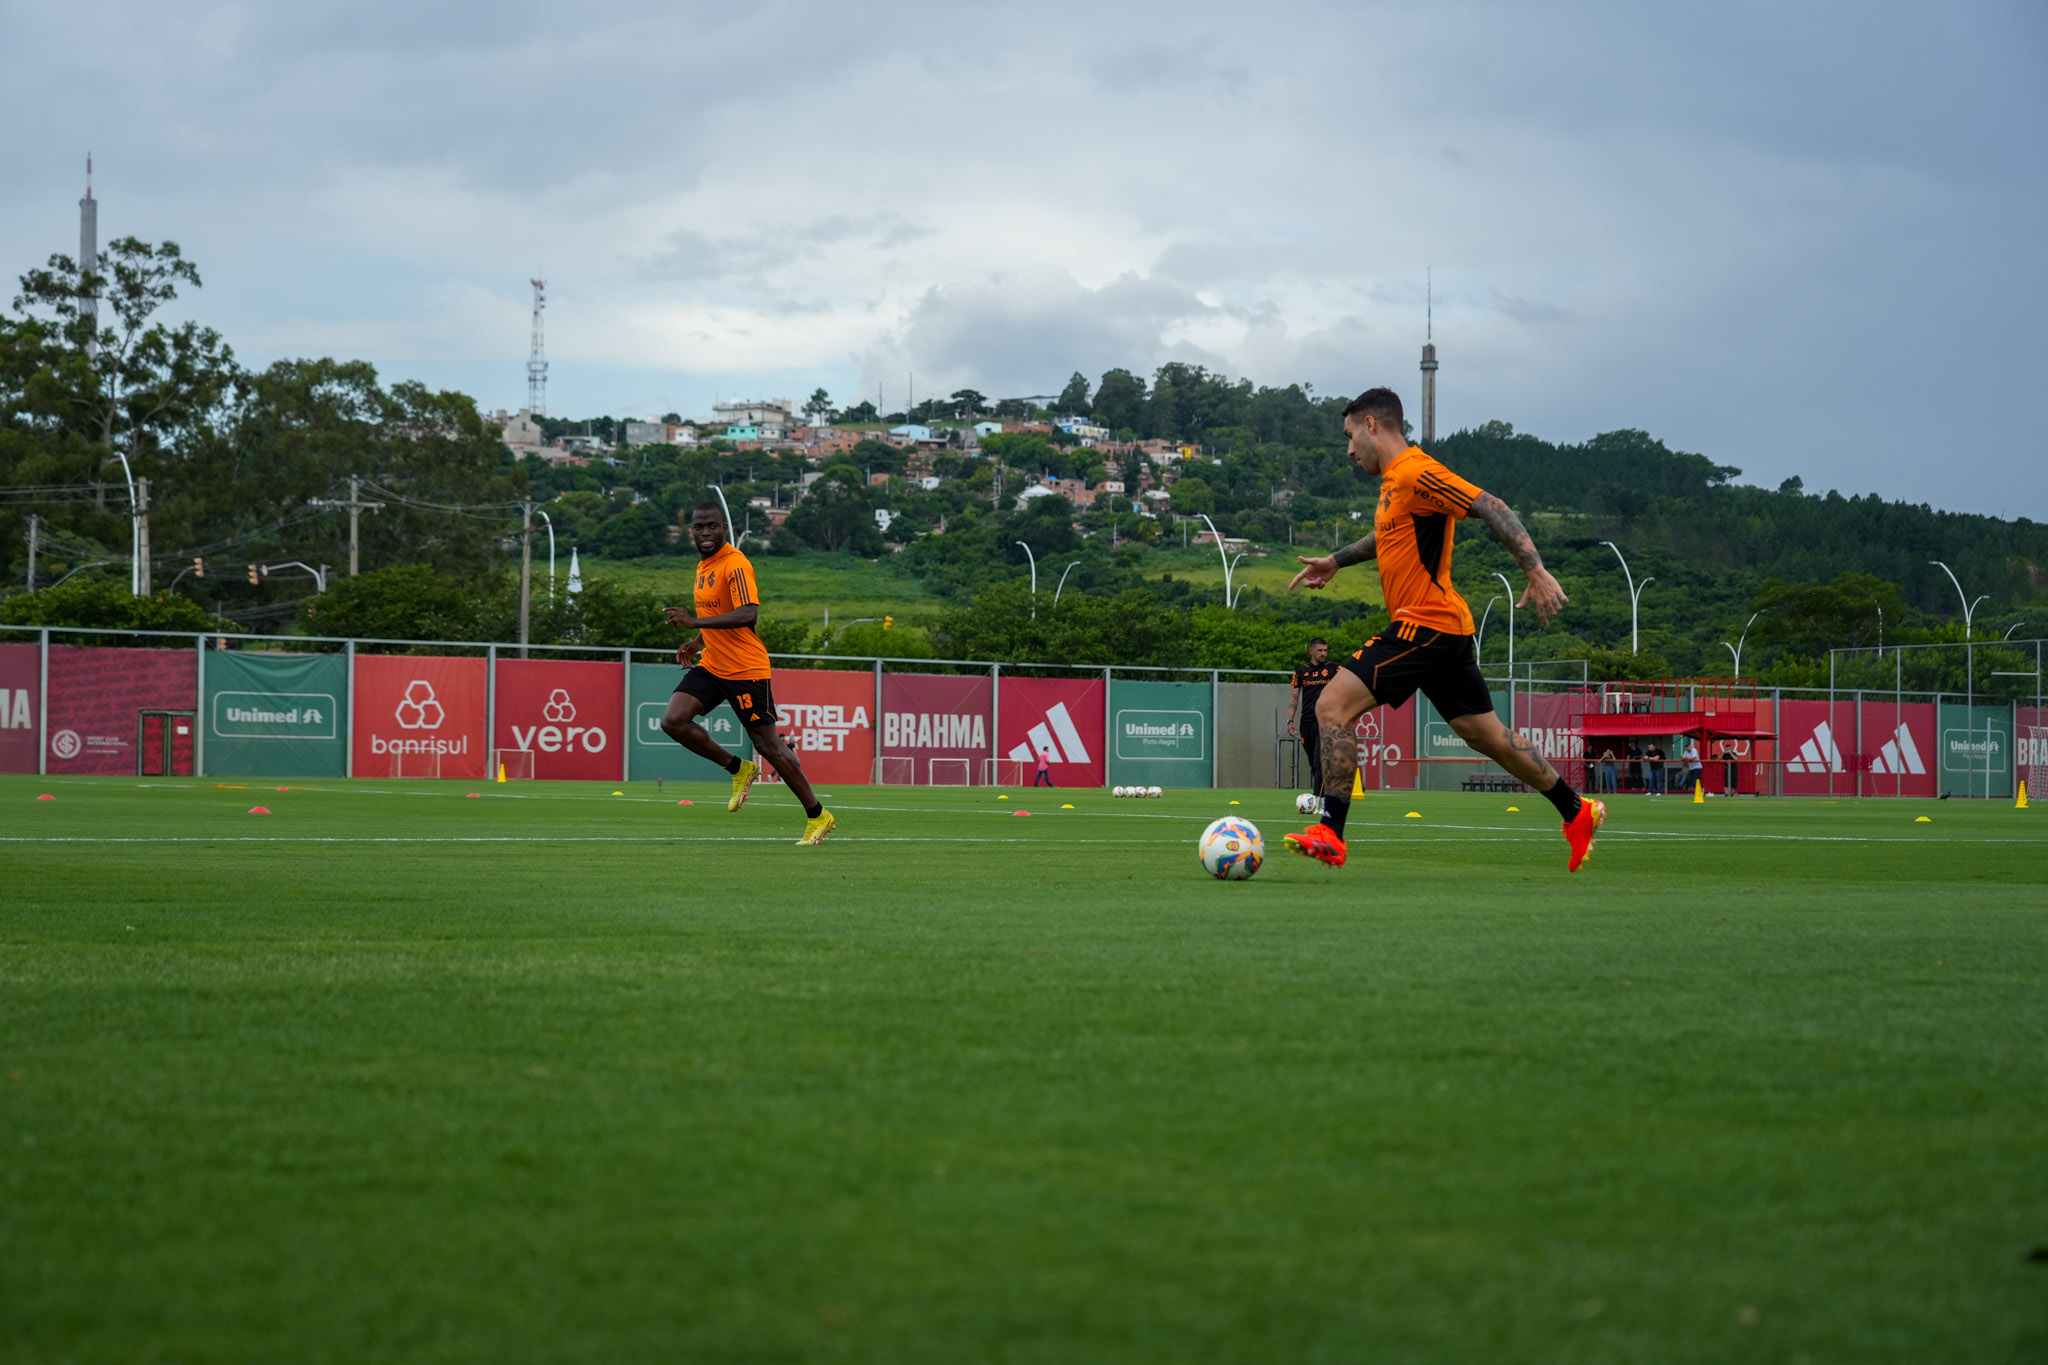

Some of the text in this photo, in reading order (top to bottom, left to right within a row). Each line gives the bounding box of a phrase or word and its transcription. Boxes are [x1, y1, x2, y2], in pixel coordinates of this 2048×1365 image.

[1414, 486, 1444, 508] vero
[736, 693, 753, 710] 13
[227, 707, 298, 724] Unimed
[774, 704, 870, 728] STRELA
[512, 725, 607, 753] vero
[802, 728, 850, 752] BET
[884, 712, 986, 749] BRAHMA
[1125, 723, 1176, 735] Unimed
[372, 734, 467, 755] banrisul
[1433, 734, 1468, 747] Unim
[1357, 744, 1402, 766] ero
